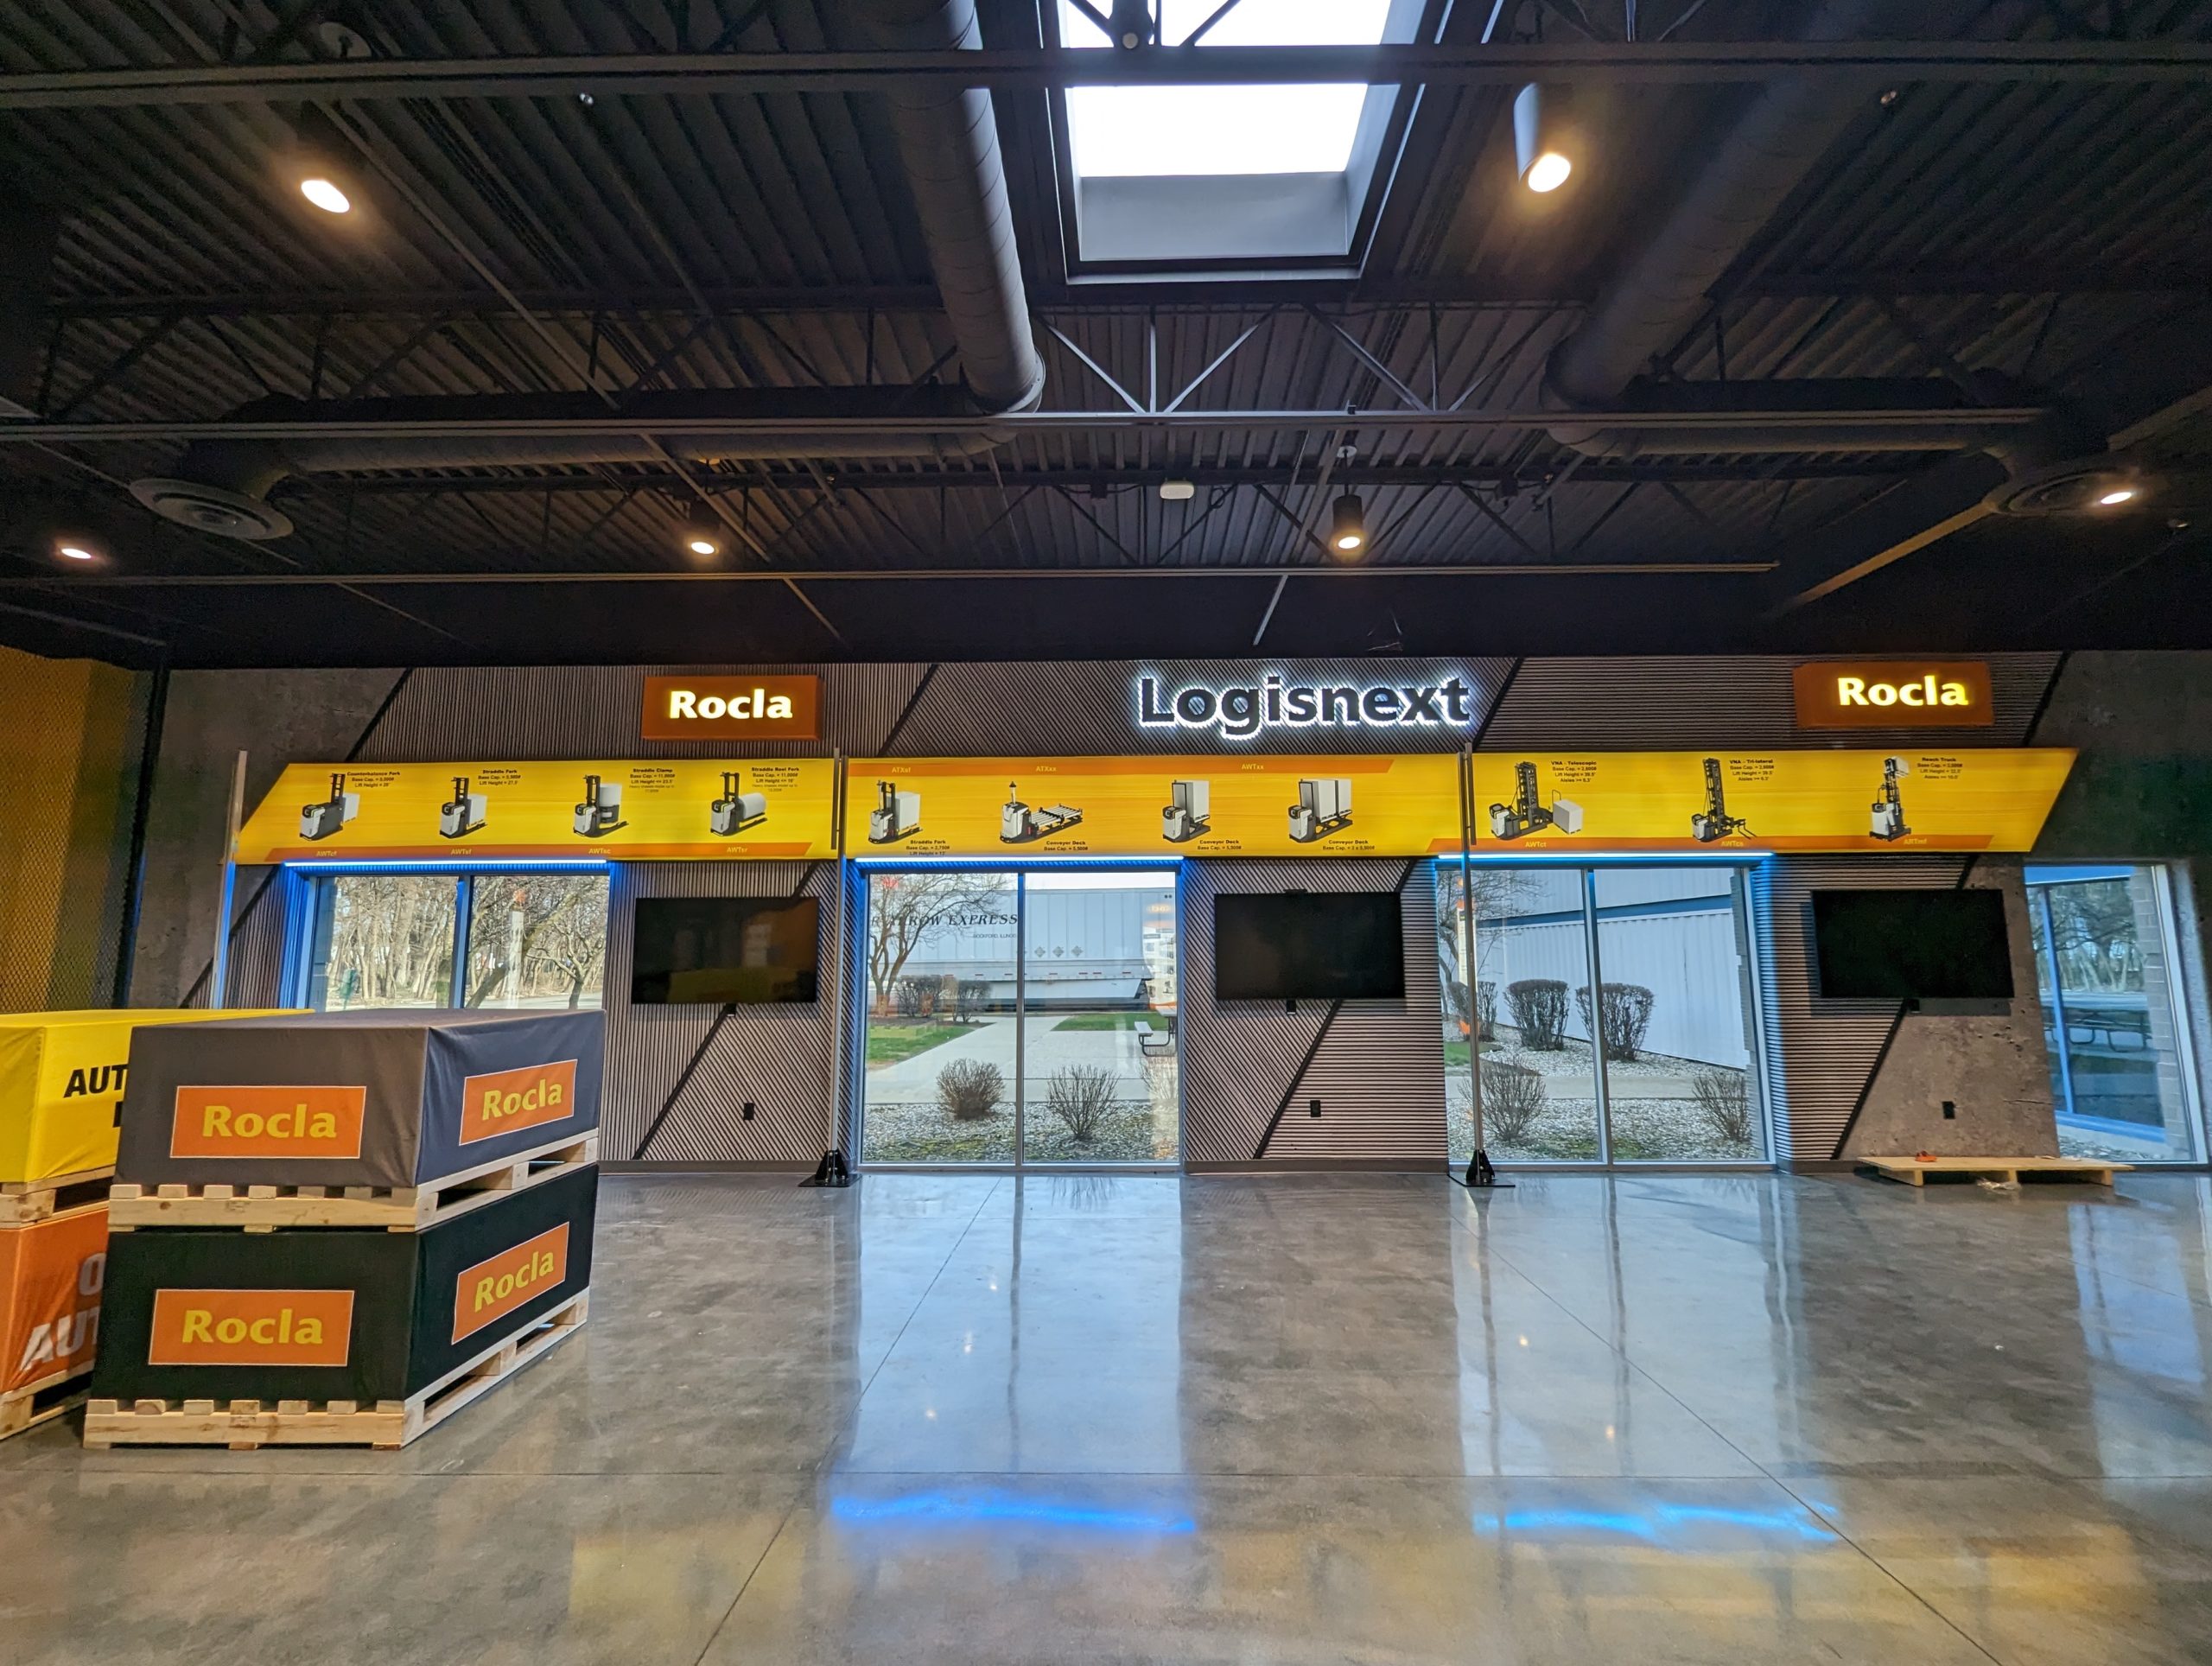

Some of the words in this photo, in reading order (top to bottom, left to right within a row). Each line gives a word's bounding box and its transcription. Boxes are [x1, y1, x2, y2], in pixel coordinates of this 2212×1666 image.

[670, 689, 793, 719] Rocla
[1139, 676, 1470, 736] Logisnext
[1837, 675, 1969, 706] Rocla
[949, 914, 1018, 925] EXPRESS
[482, 1078, 563, 1121] Rocla
[202, 1103, 337, 1138] Rocla
[474, 1251, 554, 1313] Rocla
[182, 1308, 323, 1345] Rocla
